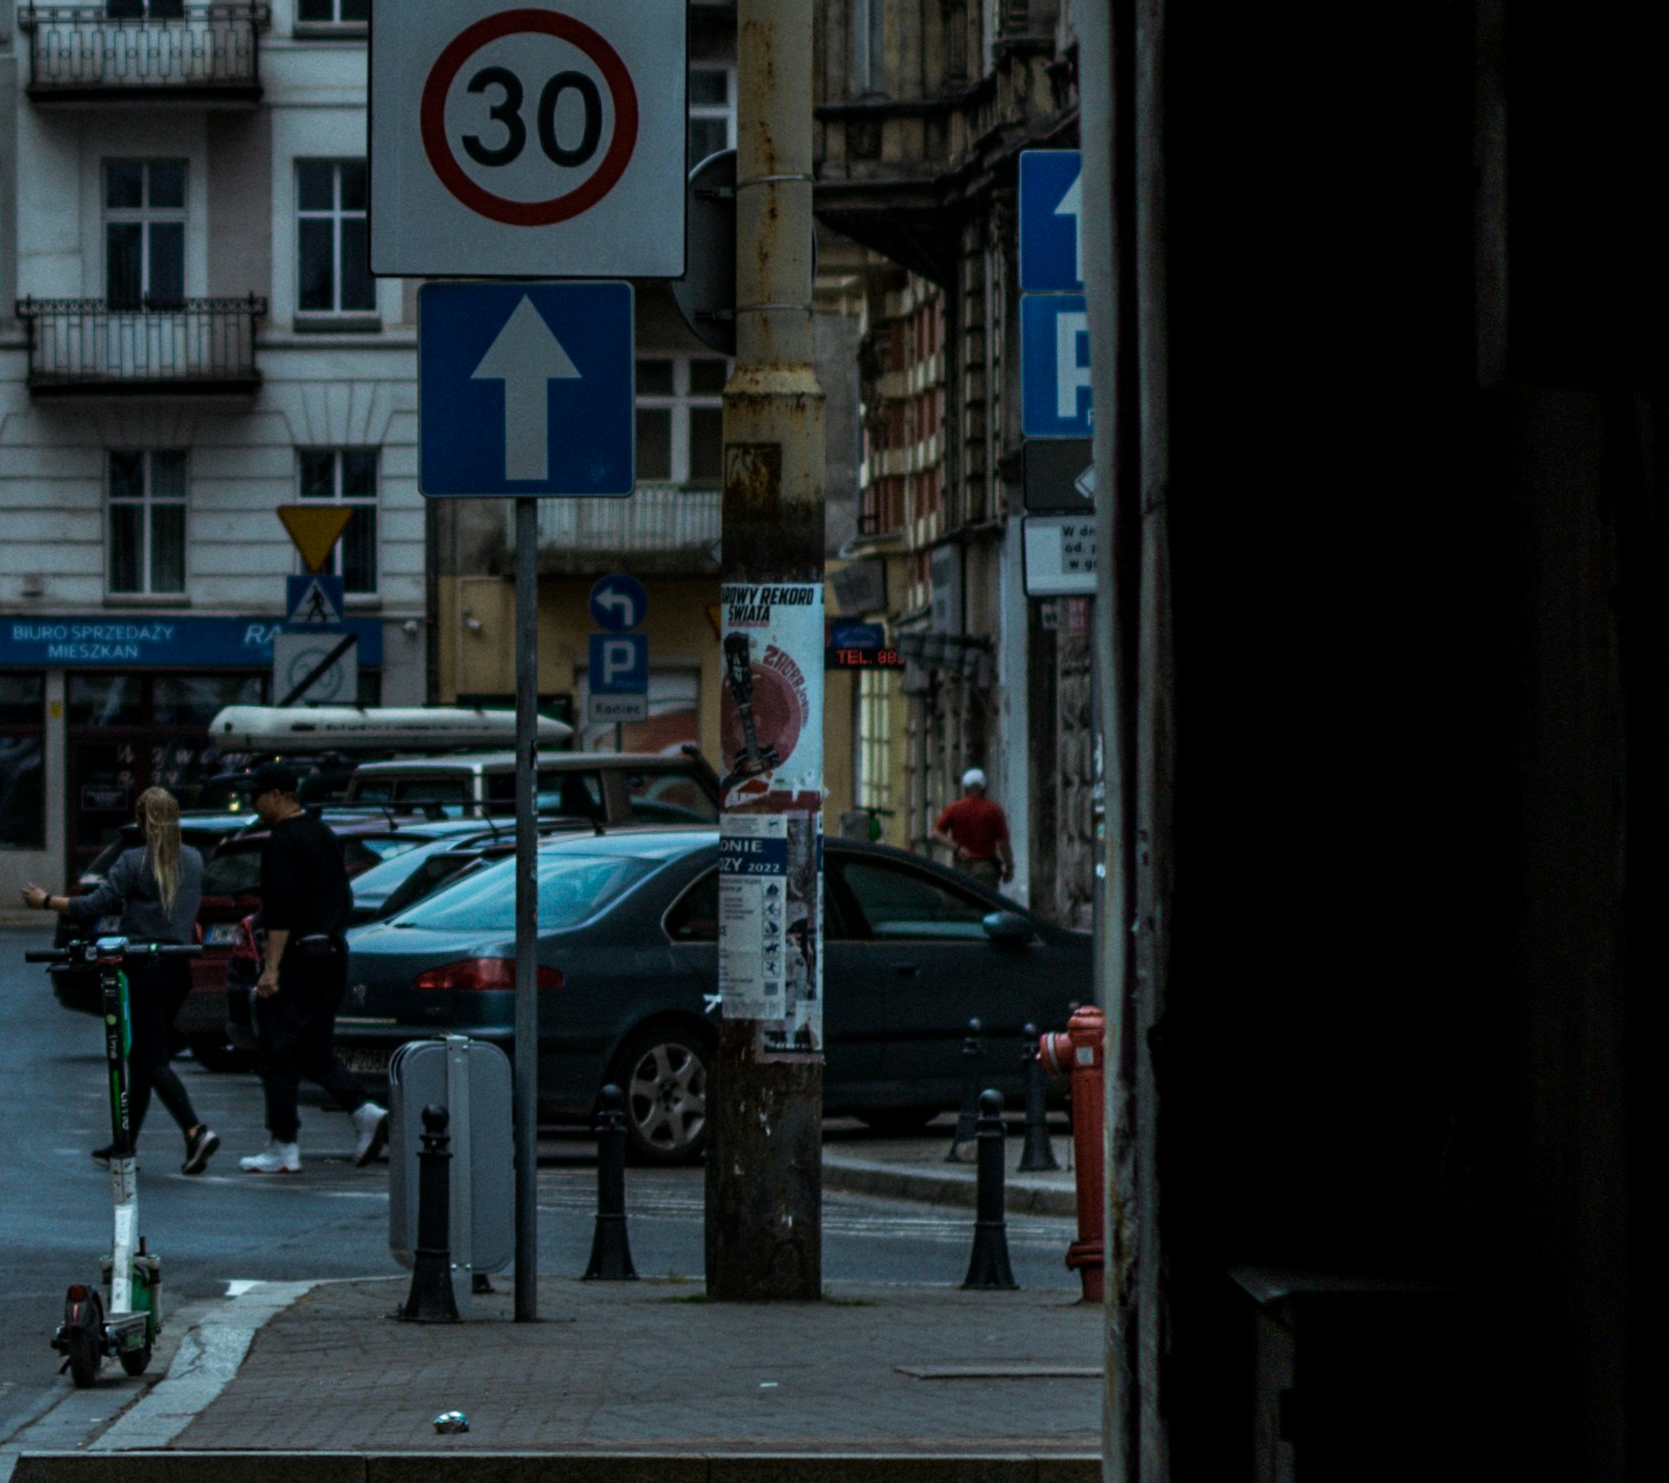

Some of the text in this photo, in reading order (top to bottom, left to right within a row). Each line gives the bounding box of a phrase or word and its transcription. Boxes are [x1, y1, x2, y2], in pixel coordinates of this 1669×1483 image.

[460, 66, 603, 167] 30
[13, 625, 68, 642] BIURO
[603, 639, 635, 685] P
[748, 862, 781, 874] 2022
